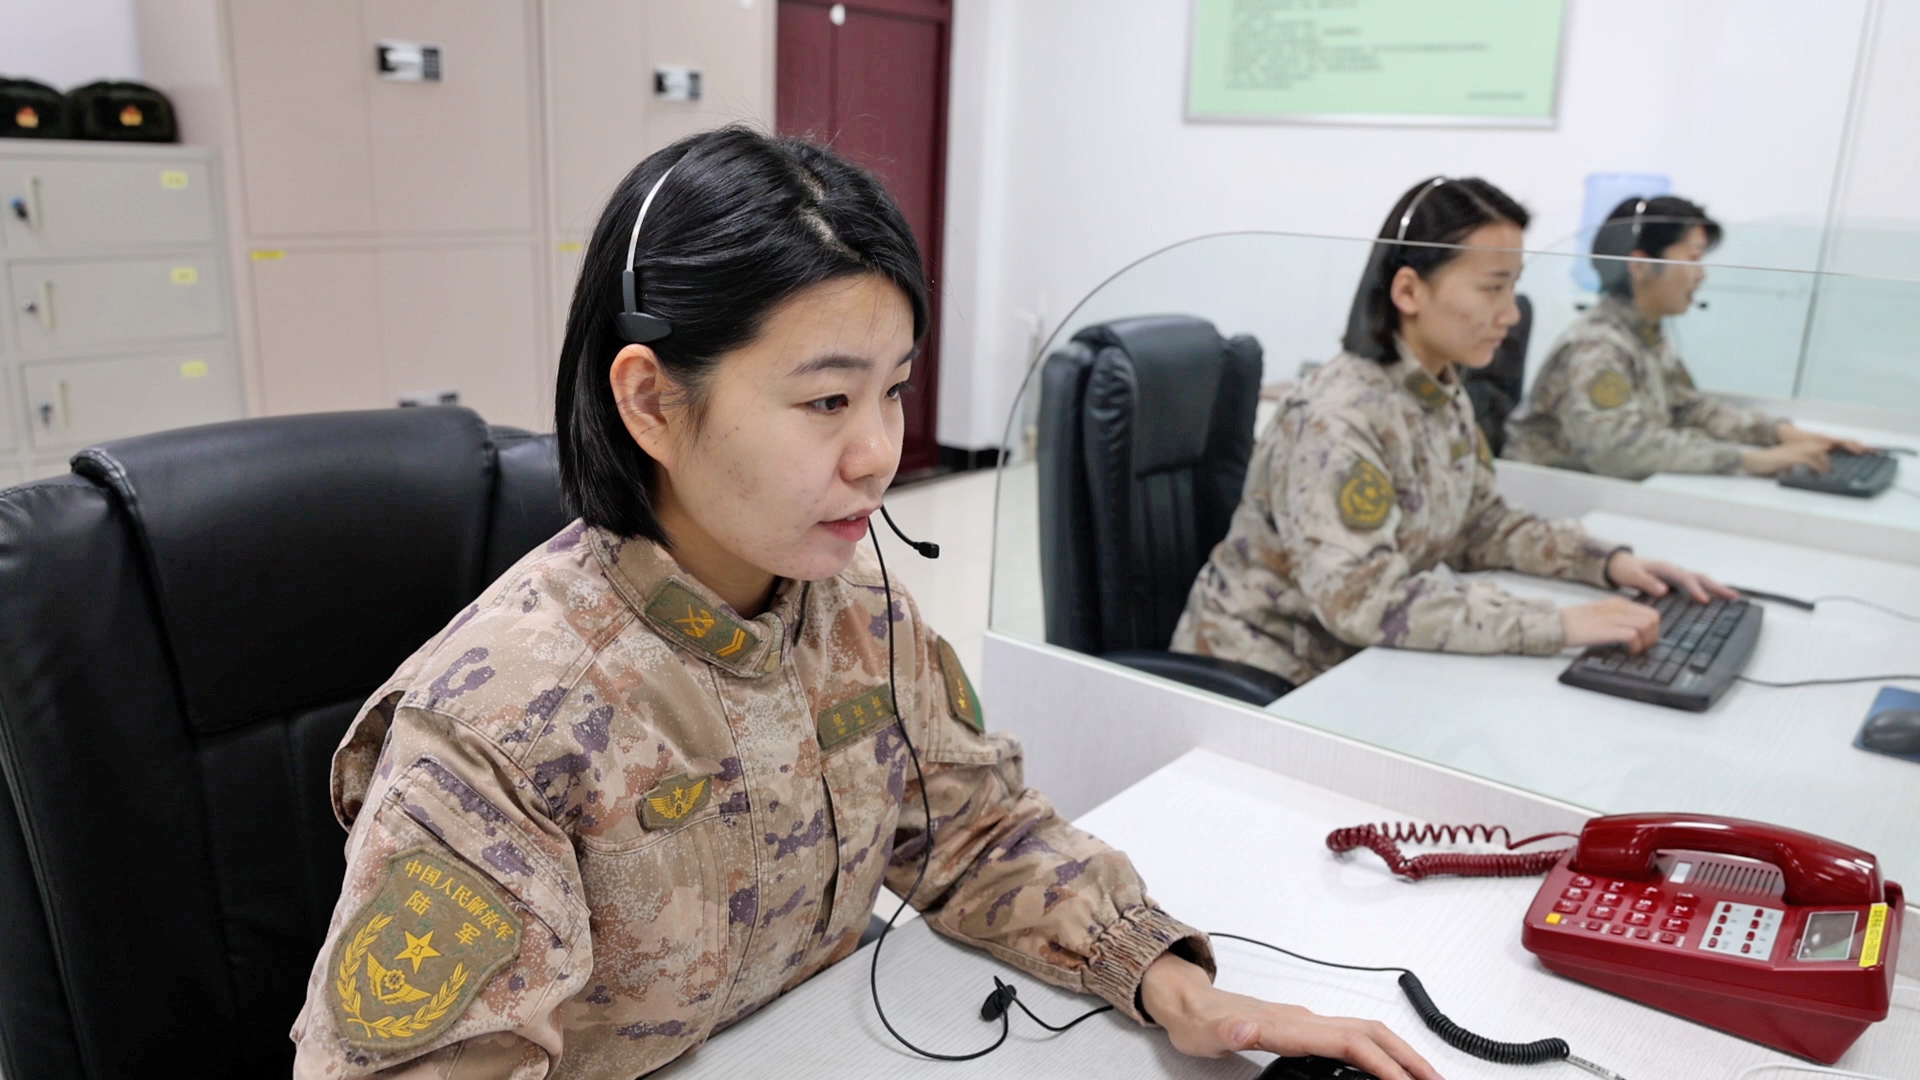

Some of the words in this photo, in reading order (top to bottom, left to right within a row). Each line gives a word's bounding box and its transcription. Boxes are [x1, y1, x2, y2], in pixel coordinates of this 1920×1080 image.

[405, 860, 514, 940] 中国人民解放军
